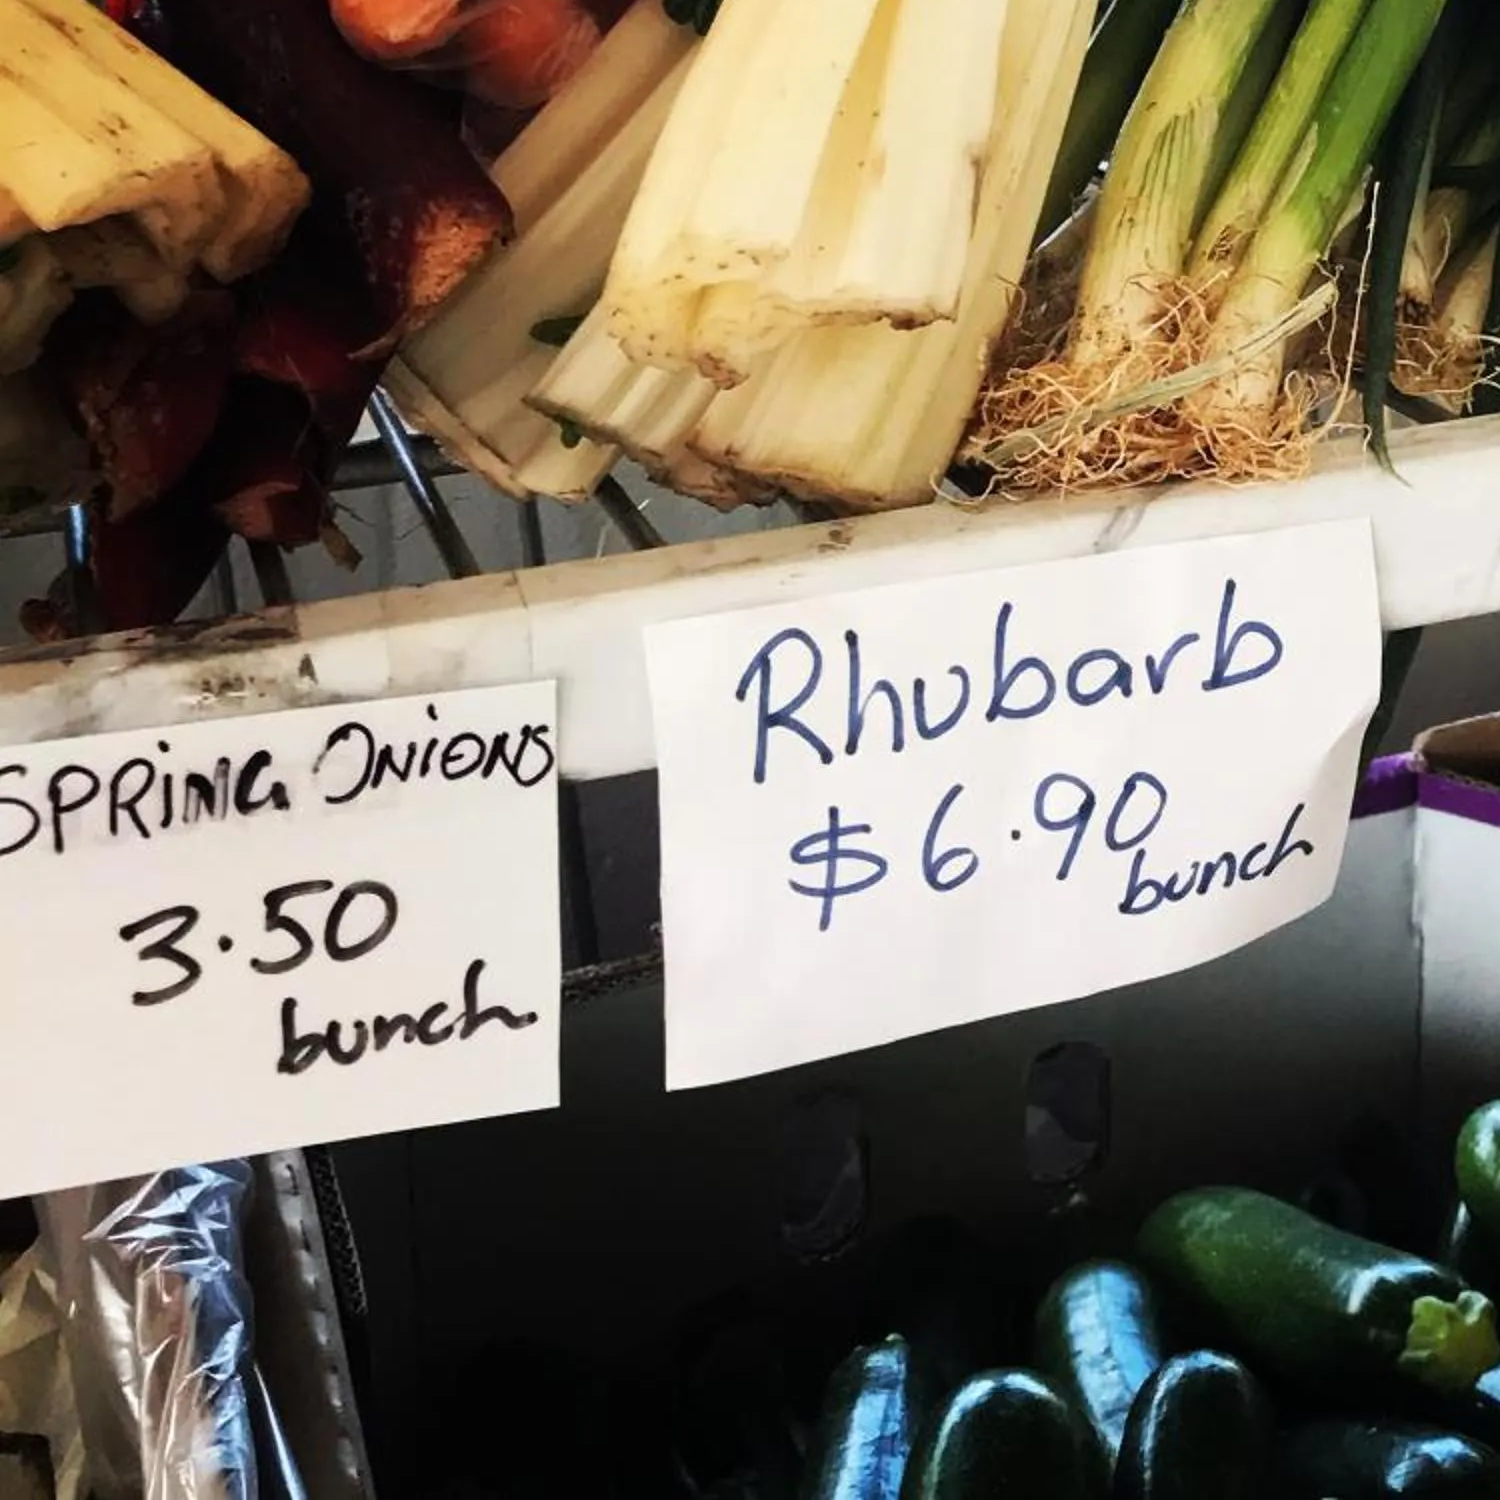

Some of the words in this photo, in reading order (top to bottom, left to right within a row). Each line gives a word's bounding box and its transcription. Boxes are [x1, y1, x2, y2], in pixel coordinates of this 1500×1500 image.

[736, 579, 1283, 783] Rhubarb
[1118, 803, 1314, 915] bunch
[119, 880, 399, 1006] 3.50
[276, 959, 537, 1075] bunch
